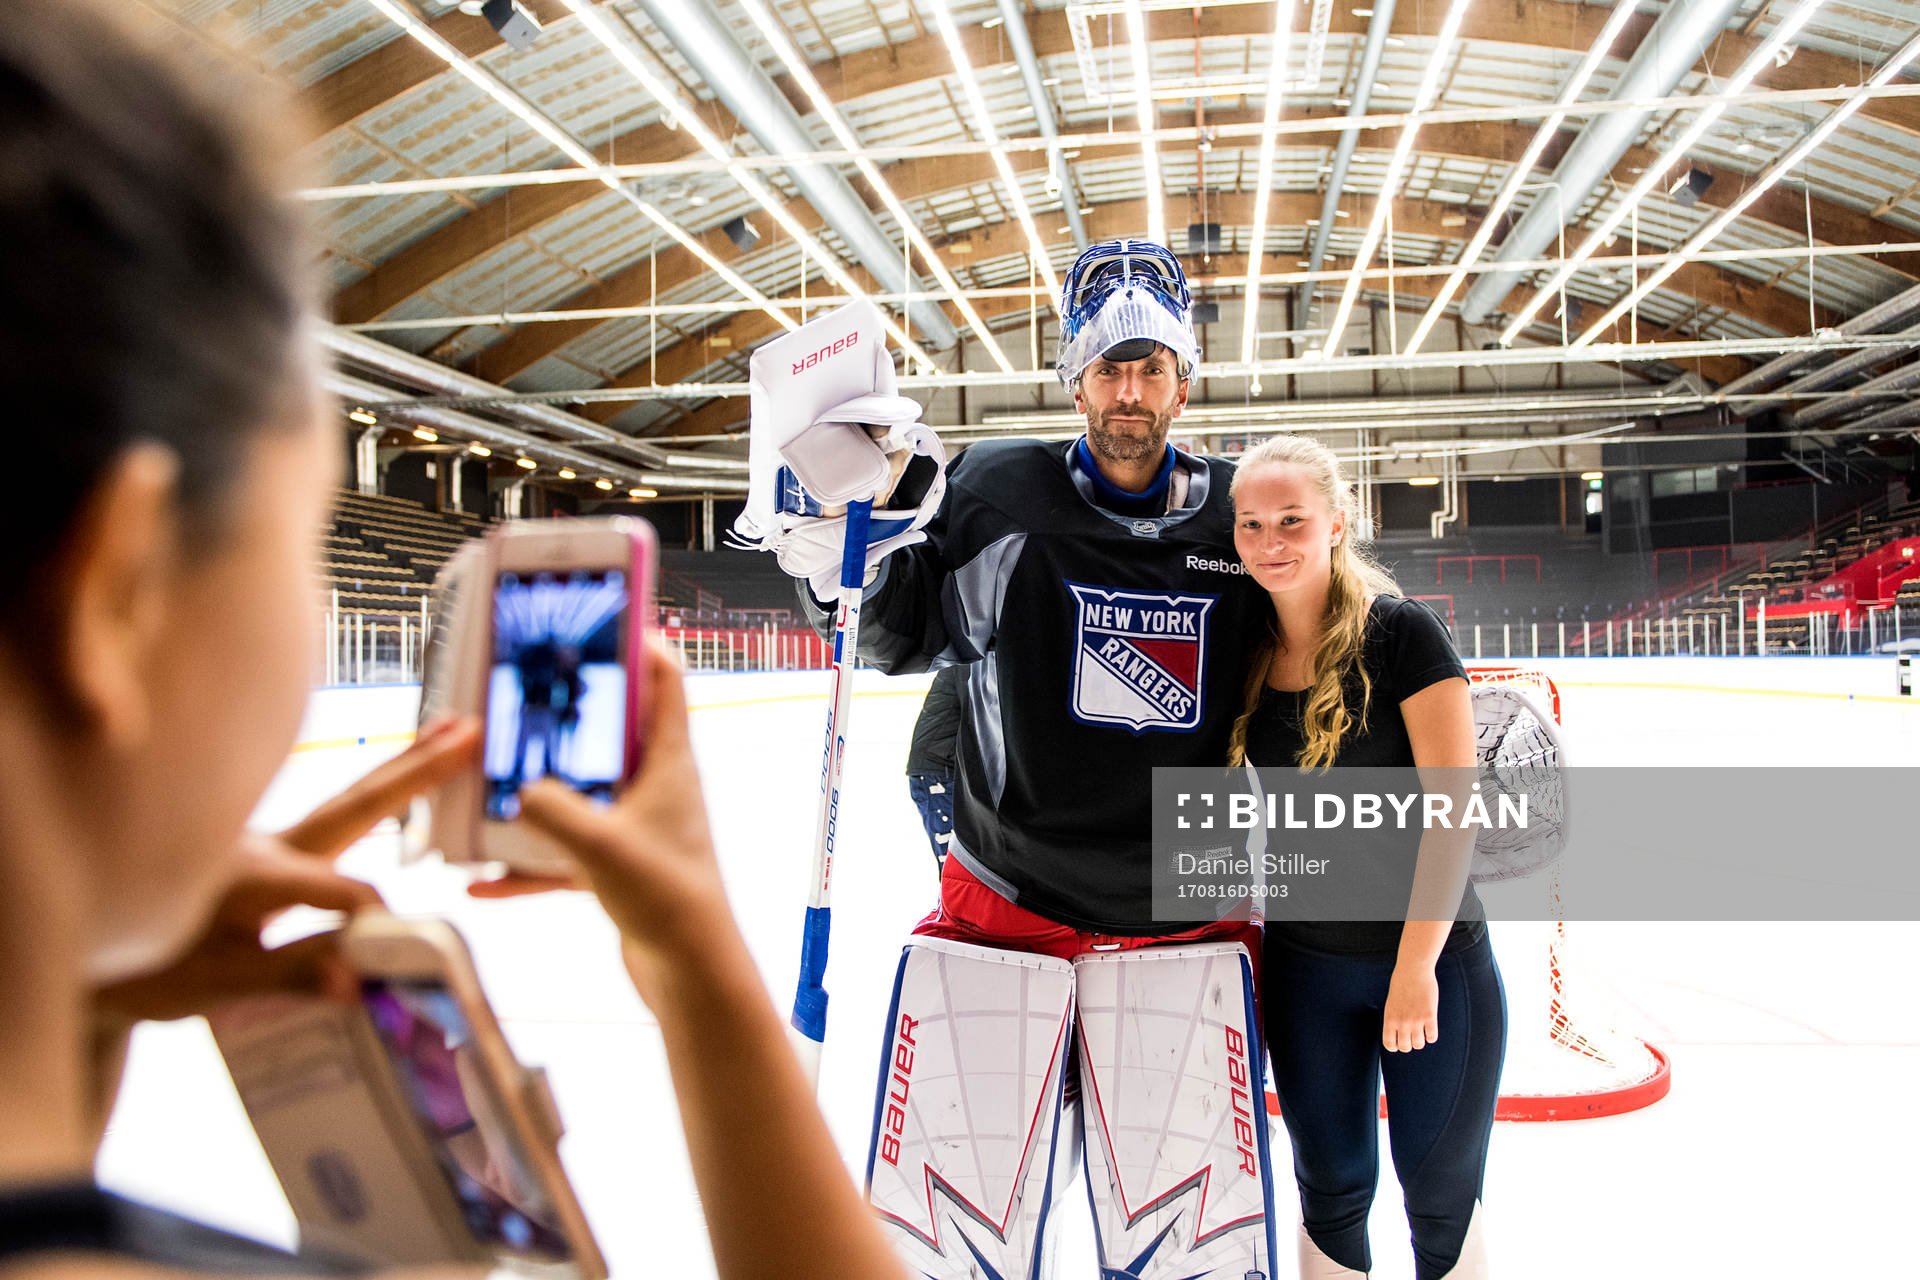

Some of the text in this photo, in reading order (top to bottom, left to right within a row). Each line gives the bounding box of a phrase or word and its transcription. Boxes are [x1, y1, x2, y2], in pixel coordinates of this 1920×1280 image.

[1085, 603, 1196, 634] NEW YORK
[1098, 636, 1192, 718] RANGERS
[826, 788, 839, 854] 9000
